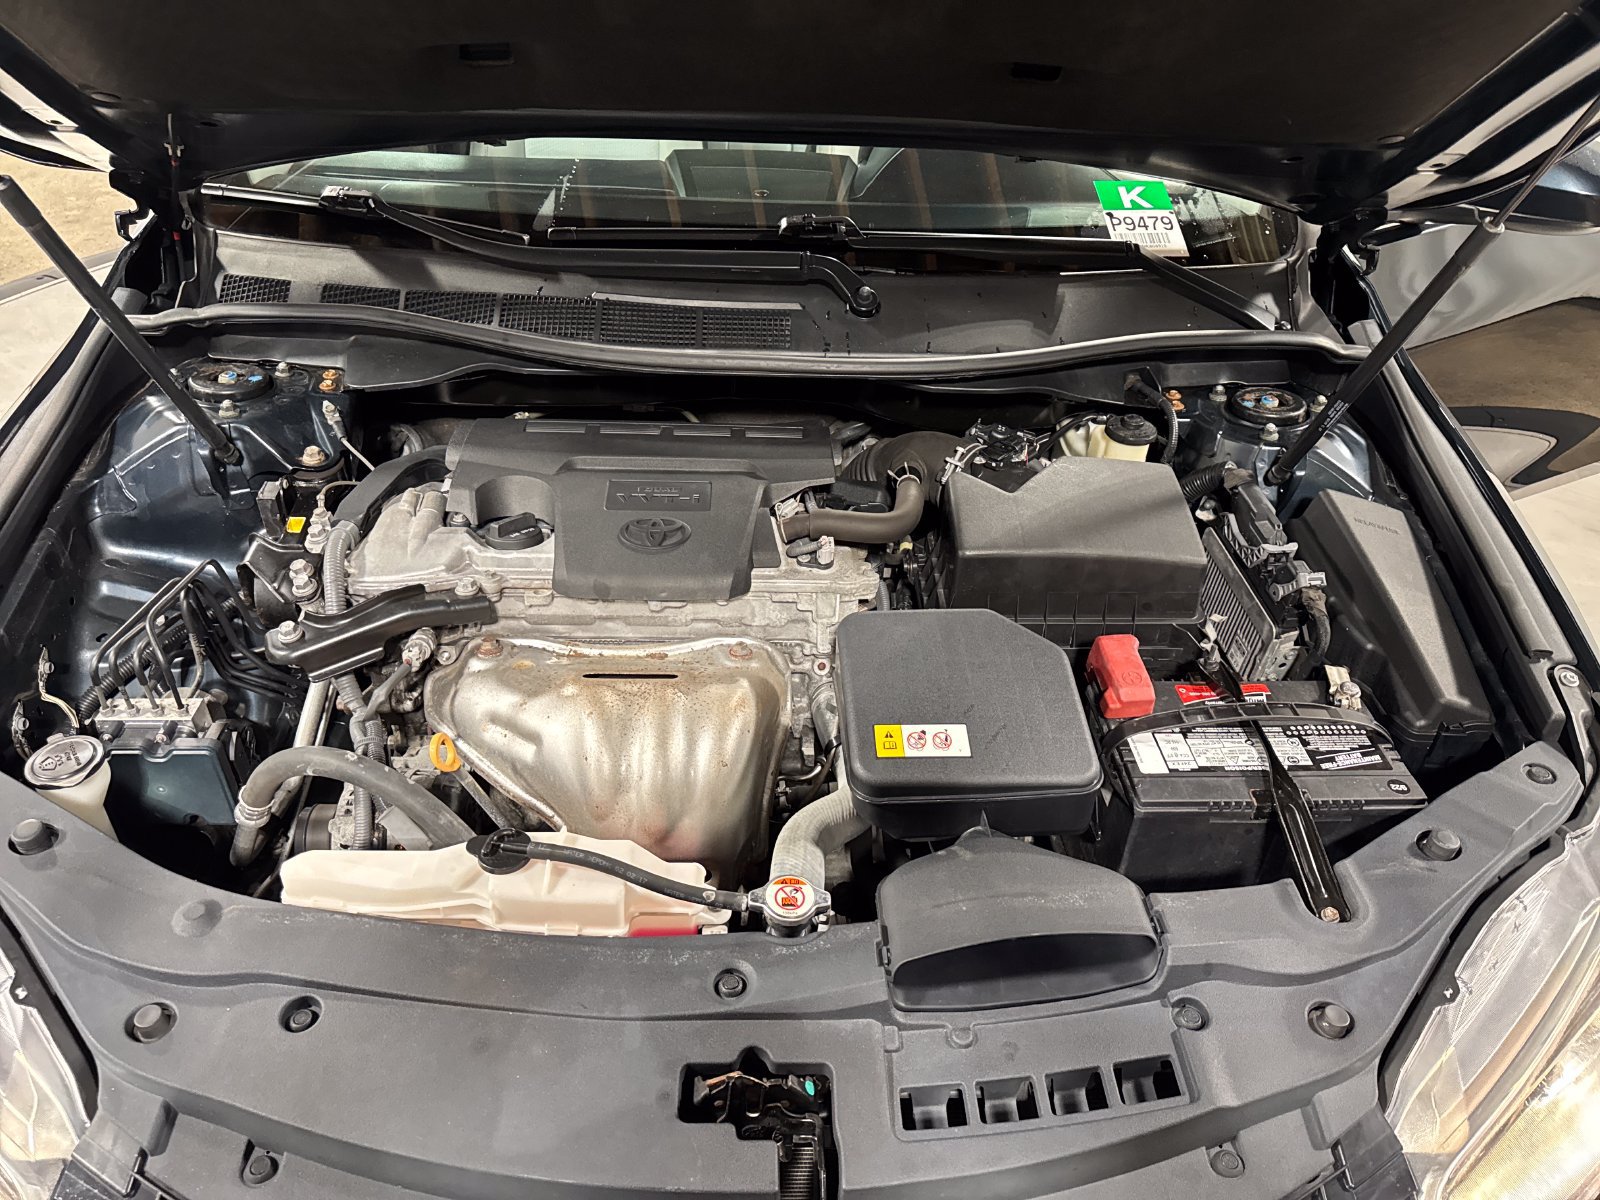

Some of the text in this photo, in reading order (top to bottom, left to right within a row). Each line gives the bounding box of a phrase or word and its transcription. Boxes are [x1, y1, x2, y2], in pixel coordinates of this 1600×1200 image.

[1117, 185, 1154, 209] K
[1110, 215, 1174, 232] P9479
[1319, 754, 1382, 770] MAINTENANCE-FREE
[1334, 752, 1363, 761] BATTERY
